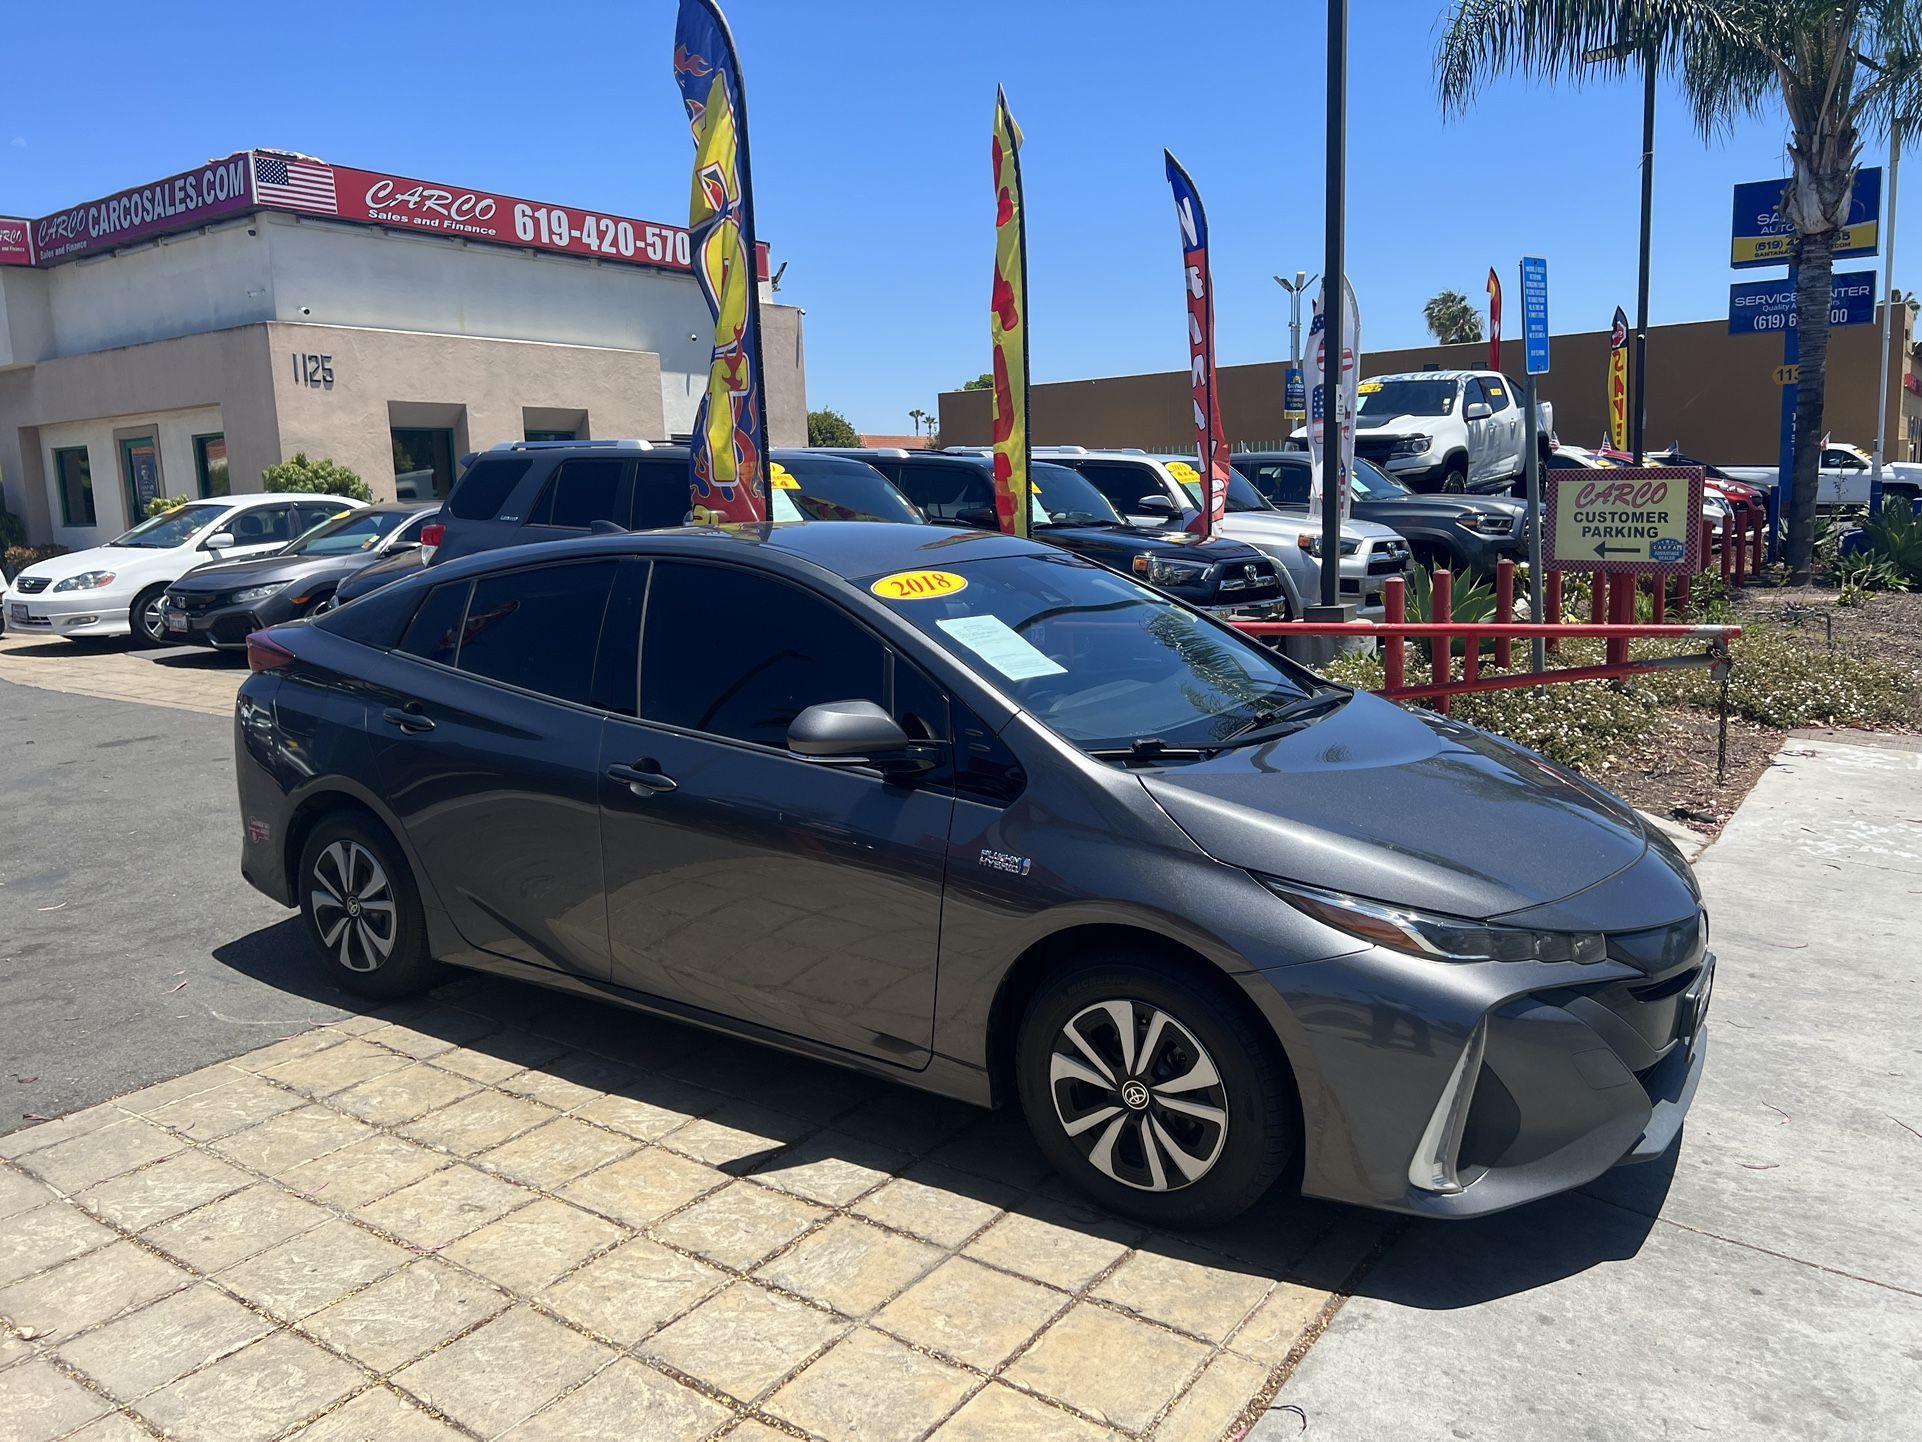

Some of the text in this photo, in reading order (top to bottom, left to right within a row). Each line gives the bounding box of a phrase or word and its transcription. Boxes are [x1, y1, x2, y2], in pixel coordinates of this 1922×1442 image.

[88, 159, 244, 238] CARCOSALES.COM
[365, 180, 497, 221] CARCO
[38, 208, 86, 247] CARCO
[368, 209, 497, 236] Sales and Finance
[514, 203, 691, 266] 619-420-570
[40, 241, 87, 260] Sales and Finance
[1754, 248, 1794, 258] SANTANA
[1831, 285, 1870, 298] NTER
[1754, 313, 1785, 330] (619)
[292, 352, 335, 384] 1125
[1575, 482, 1668, 508] CARCO
[1573, 511, 1669, 524] CUSTOMER
[1581, 526, 1659, 538] PARKING
[891, 573, 951, 597] 2018
